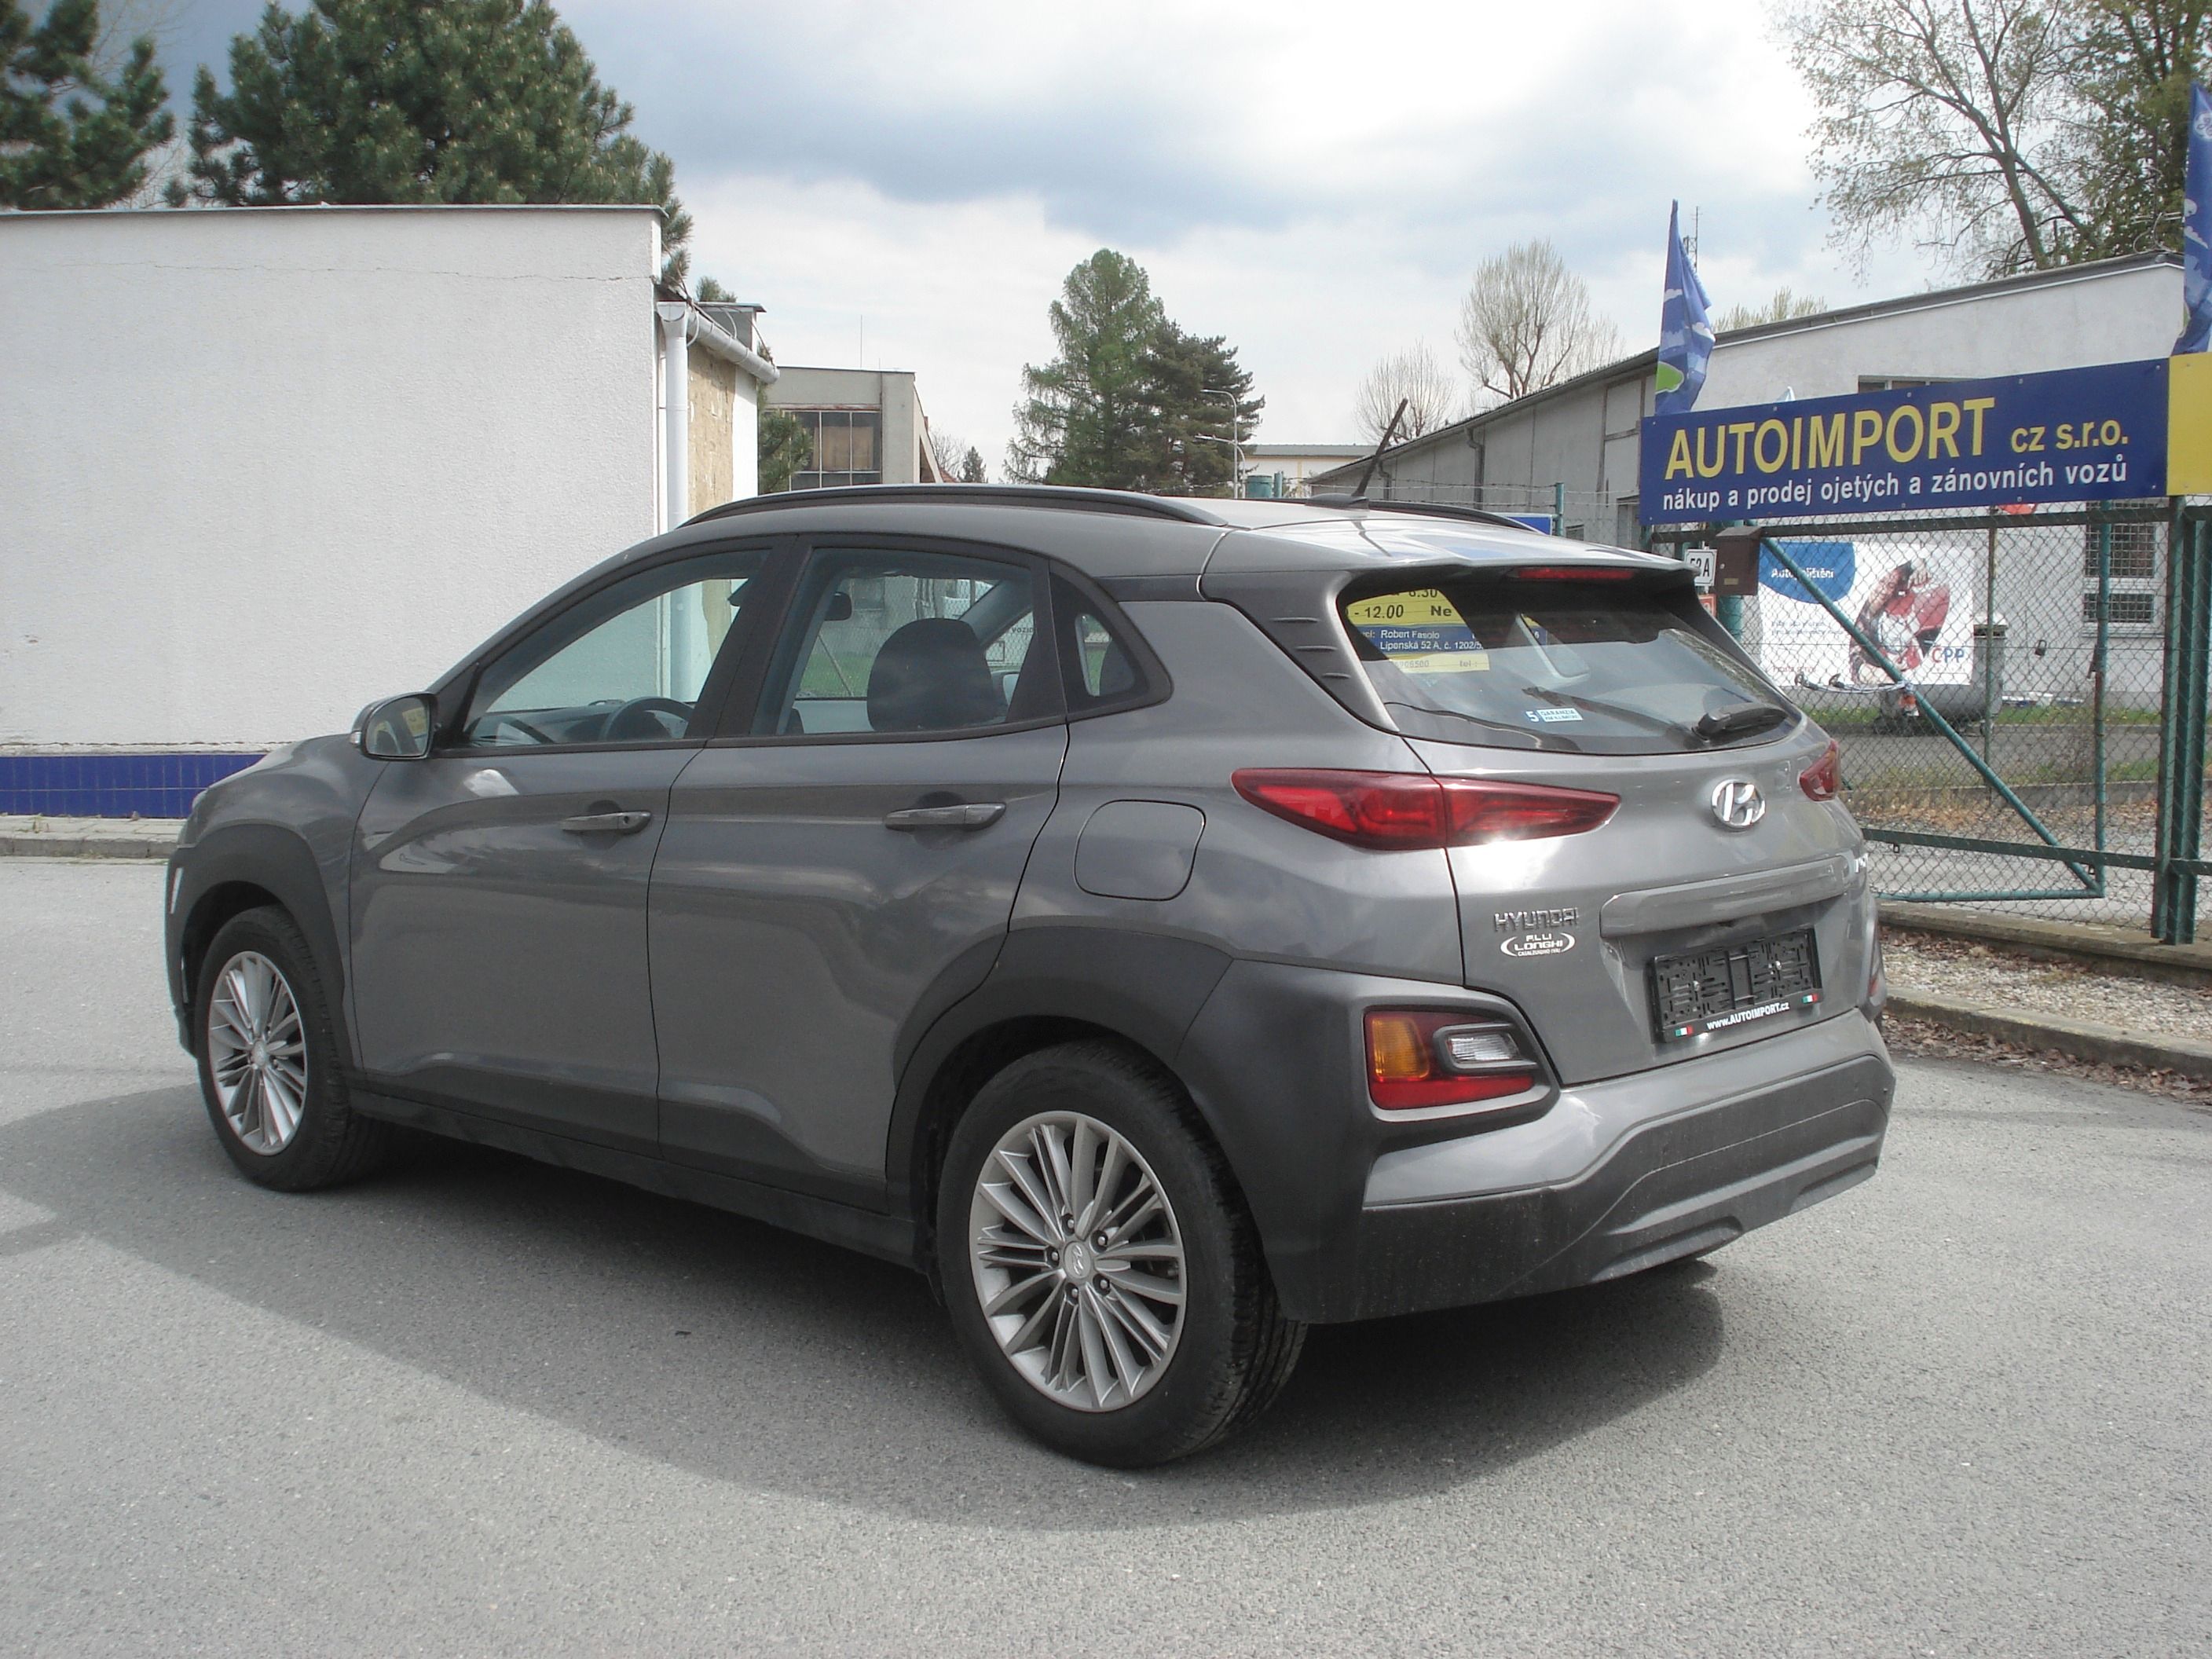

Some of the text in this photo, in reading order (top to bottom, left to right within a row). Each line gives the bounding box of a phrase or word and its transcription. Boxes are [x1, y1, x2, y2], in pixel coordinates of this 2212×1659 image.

[1664, 397, 1995, 481] AUTOIMPORT
[2055, 419, 2129, 450] s.r.o.
[1662, 453, 2127, 512] nákup a prodej ojetých a zánovních vozů
[1364, 604, 1404, 619] 12.00
[1430, 605, 1452, 617] Ne
[1494, 906, 1579, 932] HYUNDAI
[1514, 940, 1563, 951] LONGHI
[1706, 1002, 1790, 1031] www.AUTOIMPORT.cz
